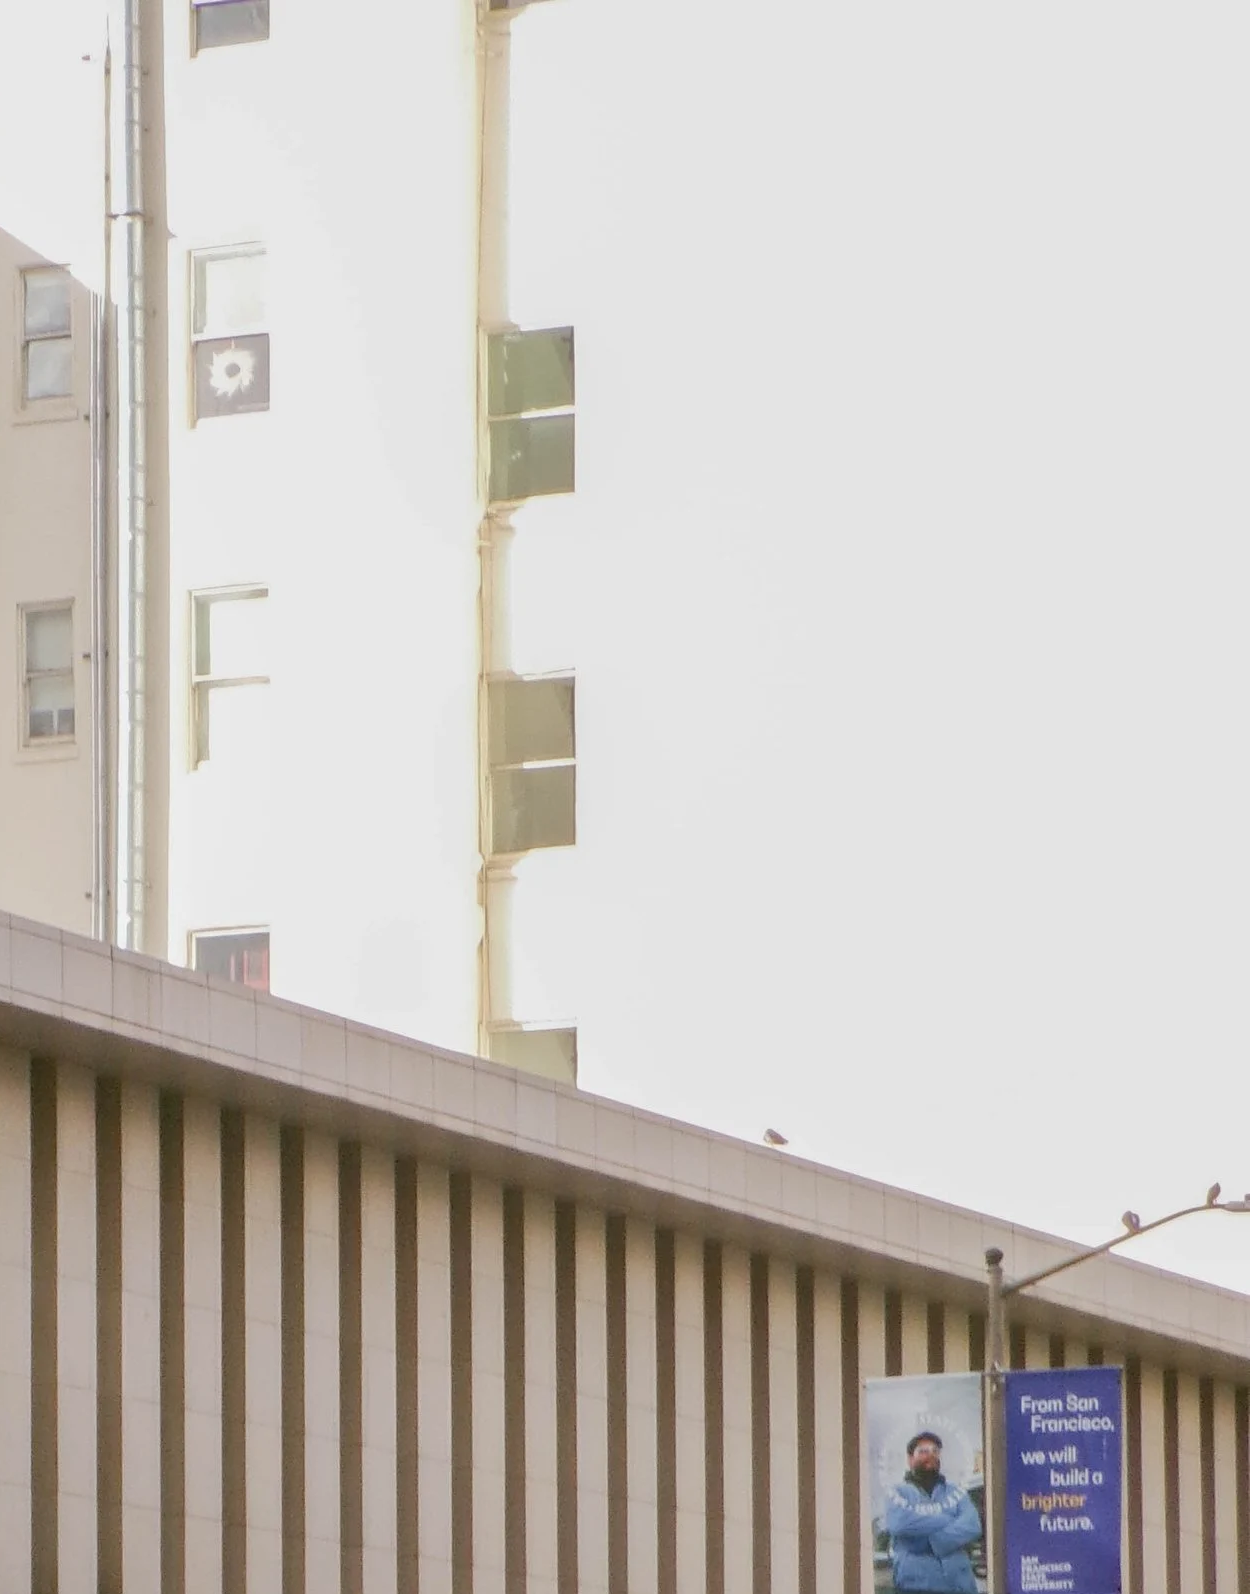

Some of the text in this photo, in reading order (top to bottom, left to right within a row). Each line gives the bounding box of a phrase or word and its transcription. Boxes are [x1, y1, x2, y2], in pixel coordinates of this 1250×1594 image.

[1021, 1393, 1099, 1413] From San
[1031, 1415, 1114, 1433] Francisco,
[1021, 1445, 1077, 1465] we will
[1050, 1469, 1103, 1487] build a
[1021, 1492, 1087, 1511] brighter
[1040, 1514, 1094, 1532] future.
[1021, 1580, 1074, 1590] UNIVERSITY
